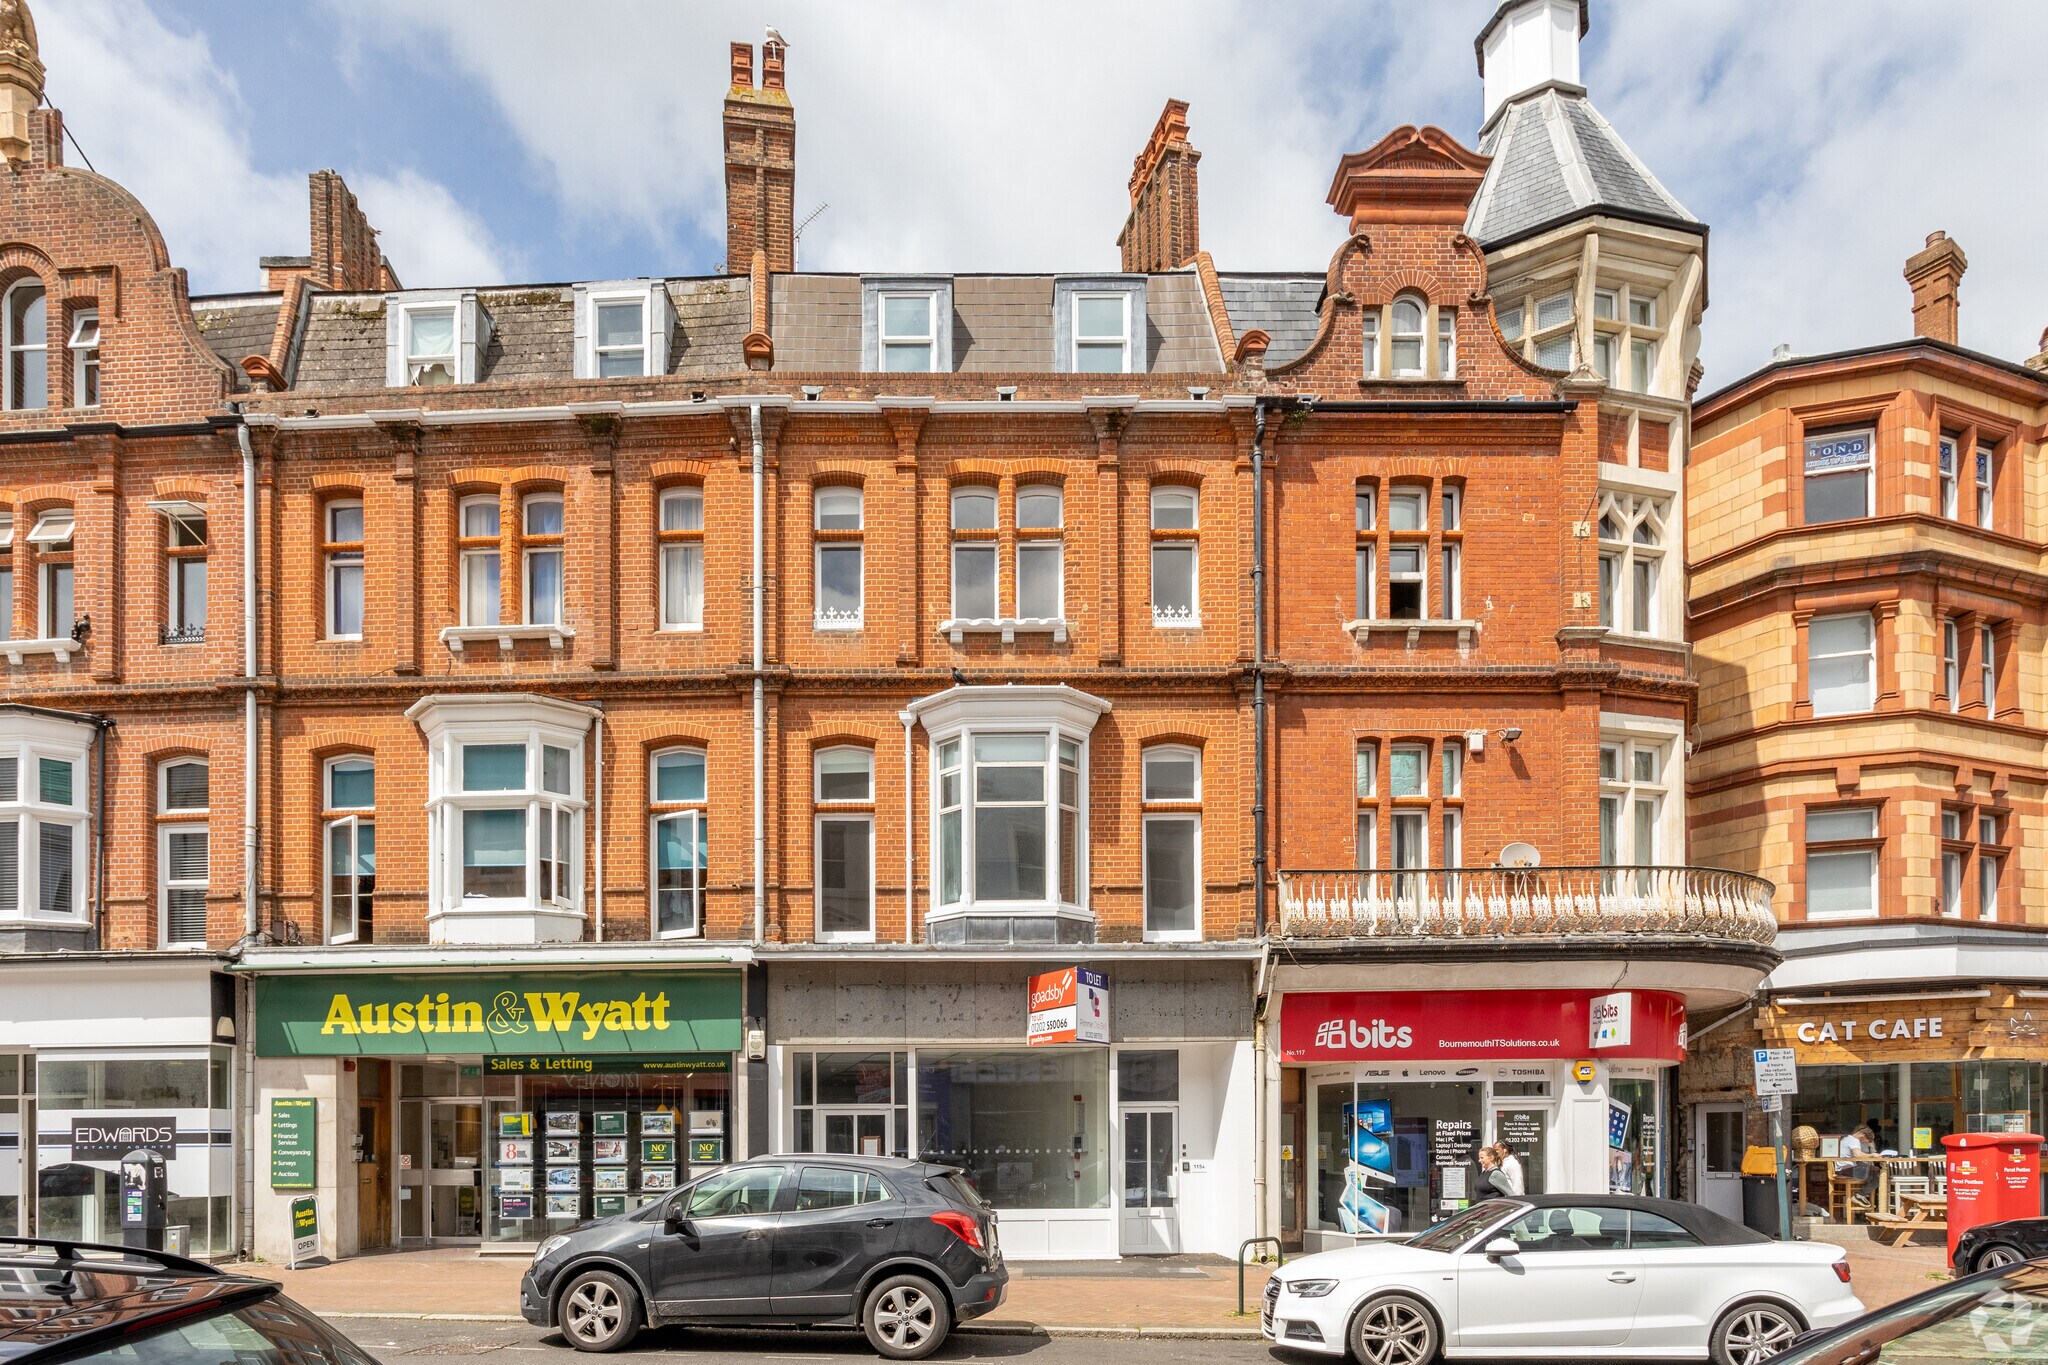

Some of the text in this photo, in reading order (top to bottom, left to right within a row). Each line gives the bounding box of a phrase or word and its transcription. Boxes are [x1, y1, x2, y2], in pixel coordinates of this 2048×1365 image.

[1085, 971, 1102, 986] TO LET
[1031, 982, 1065, 1009] goadsby
[321, 992, 484, 1034] Austin
[524, 991, 670, 1040] Wyatt
[1602, 1004, 1618, 1018] bits
[1046, 1018, 1068, 1031] 550066
[1797, 1018, 1943, 1042] CAT CAFE
[1350, 1018, 1412, 1048] bits
[1031, 1035, 1052, 1045] goadsby.com
[1438, 1038, 1560, 1048] BournemouthITSolutions.co.uk
[491, 1058, 592, 1072] Sales & Letting
[643, 1060, 726, 1069] www.austinwyatt.co.uk
[1436, 1120, 1472, 1131] Repairs
[76, 1126, 172, 1142] EDWARDS
[296, 1209, 313, 1218] Austin
[300, 1217, 315, 1227] Wyatt
[298, 1240, 315, 1250] OPEN
